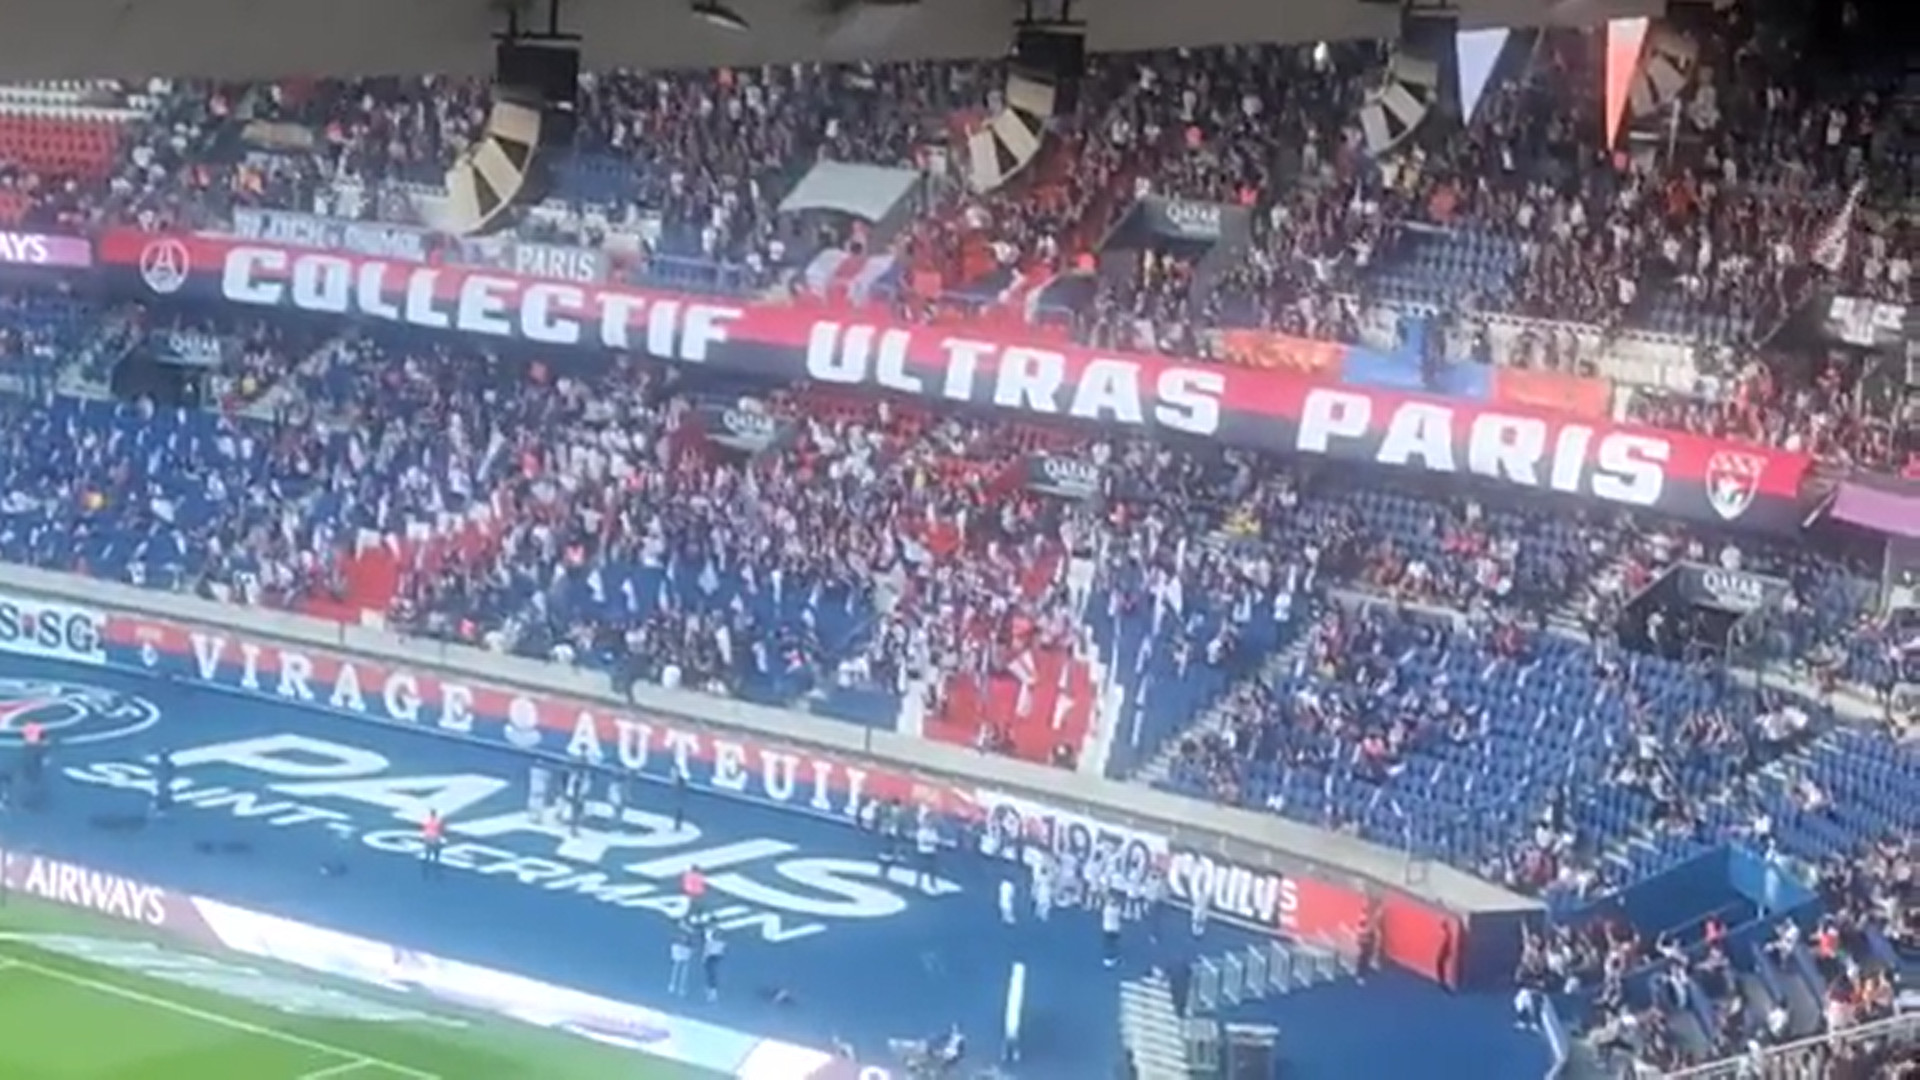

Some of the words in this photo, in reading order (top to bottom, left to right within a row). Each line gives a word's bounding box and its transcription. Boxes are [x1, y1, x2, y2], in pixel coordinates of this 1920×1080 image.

[516, 245, 594, 281] PARIS
[222, 246, 744, 363] COLLECTIF
[806, 320, 1225, 436] ULTRAS
[1297, 388, 1670, 504] PARIS
[189, 633, 474, 732] VIRAGE
[567, 711, 879, 820] AUTEUIL
[25, 855, 166, 926] AIRWAYS
[145, 733, 962, 918] PARIS
